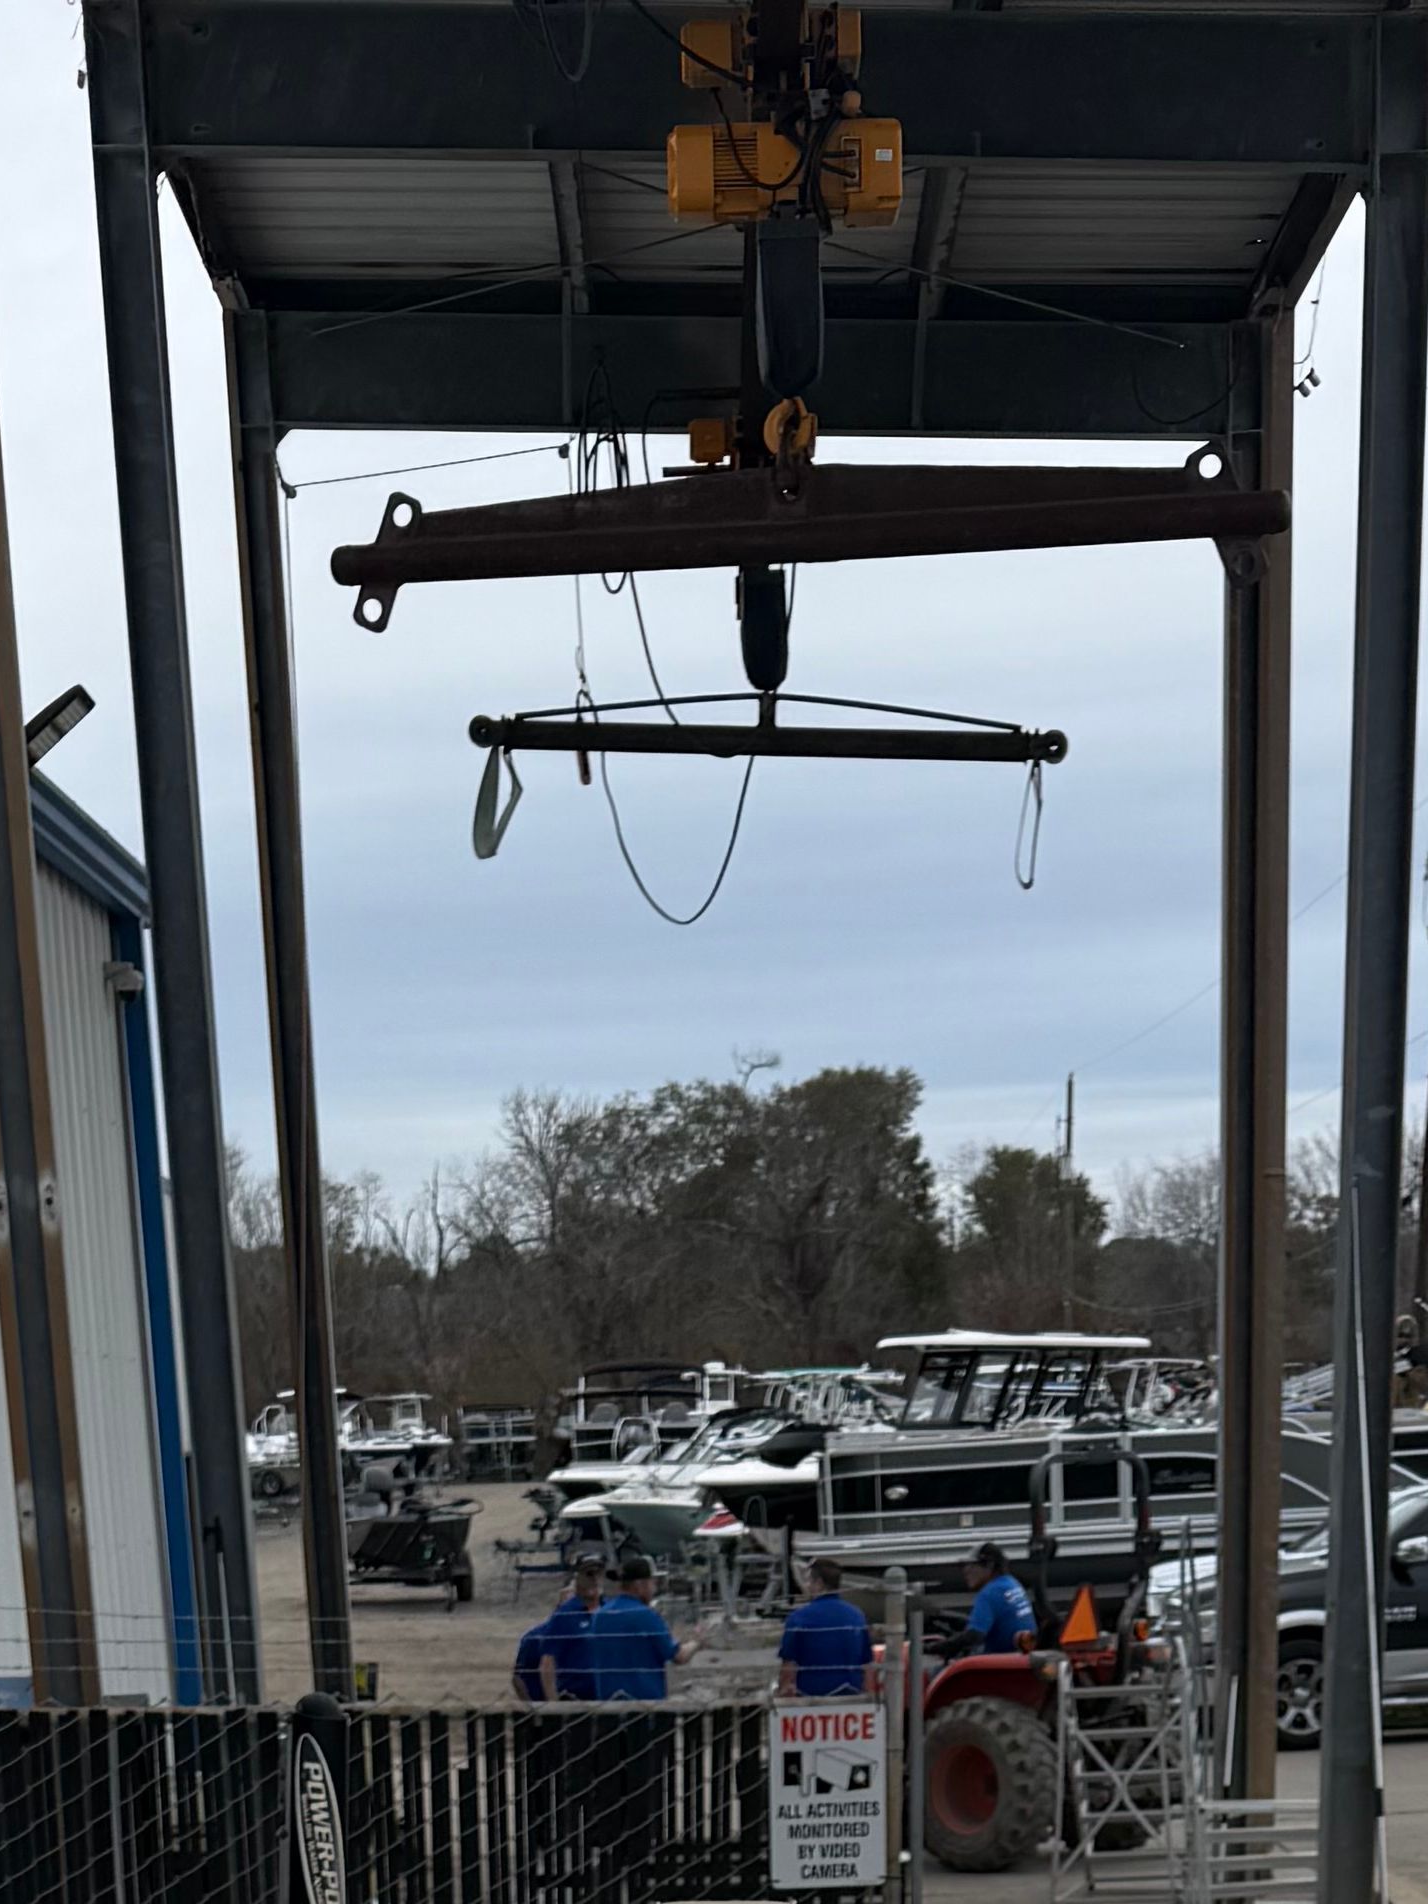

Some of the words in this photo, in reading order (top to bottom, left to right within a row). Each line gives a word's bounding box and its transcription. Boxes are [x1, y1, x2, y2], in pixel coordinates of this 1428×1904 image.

[781, 1713, 876, 1743] NOTICE
[777, 1803, 802, 1819] ALL
[807, 1801, 880, 1819] ACTIVITIES
[788, 1822, 869, 1839] MONITORED
[797, 1844, 815, 1860] BY
[819, 1843, 860, 1859] VIDEO
[801, 1862, 858, 1880] CAMERA
